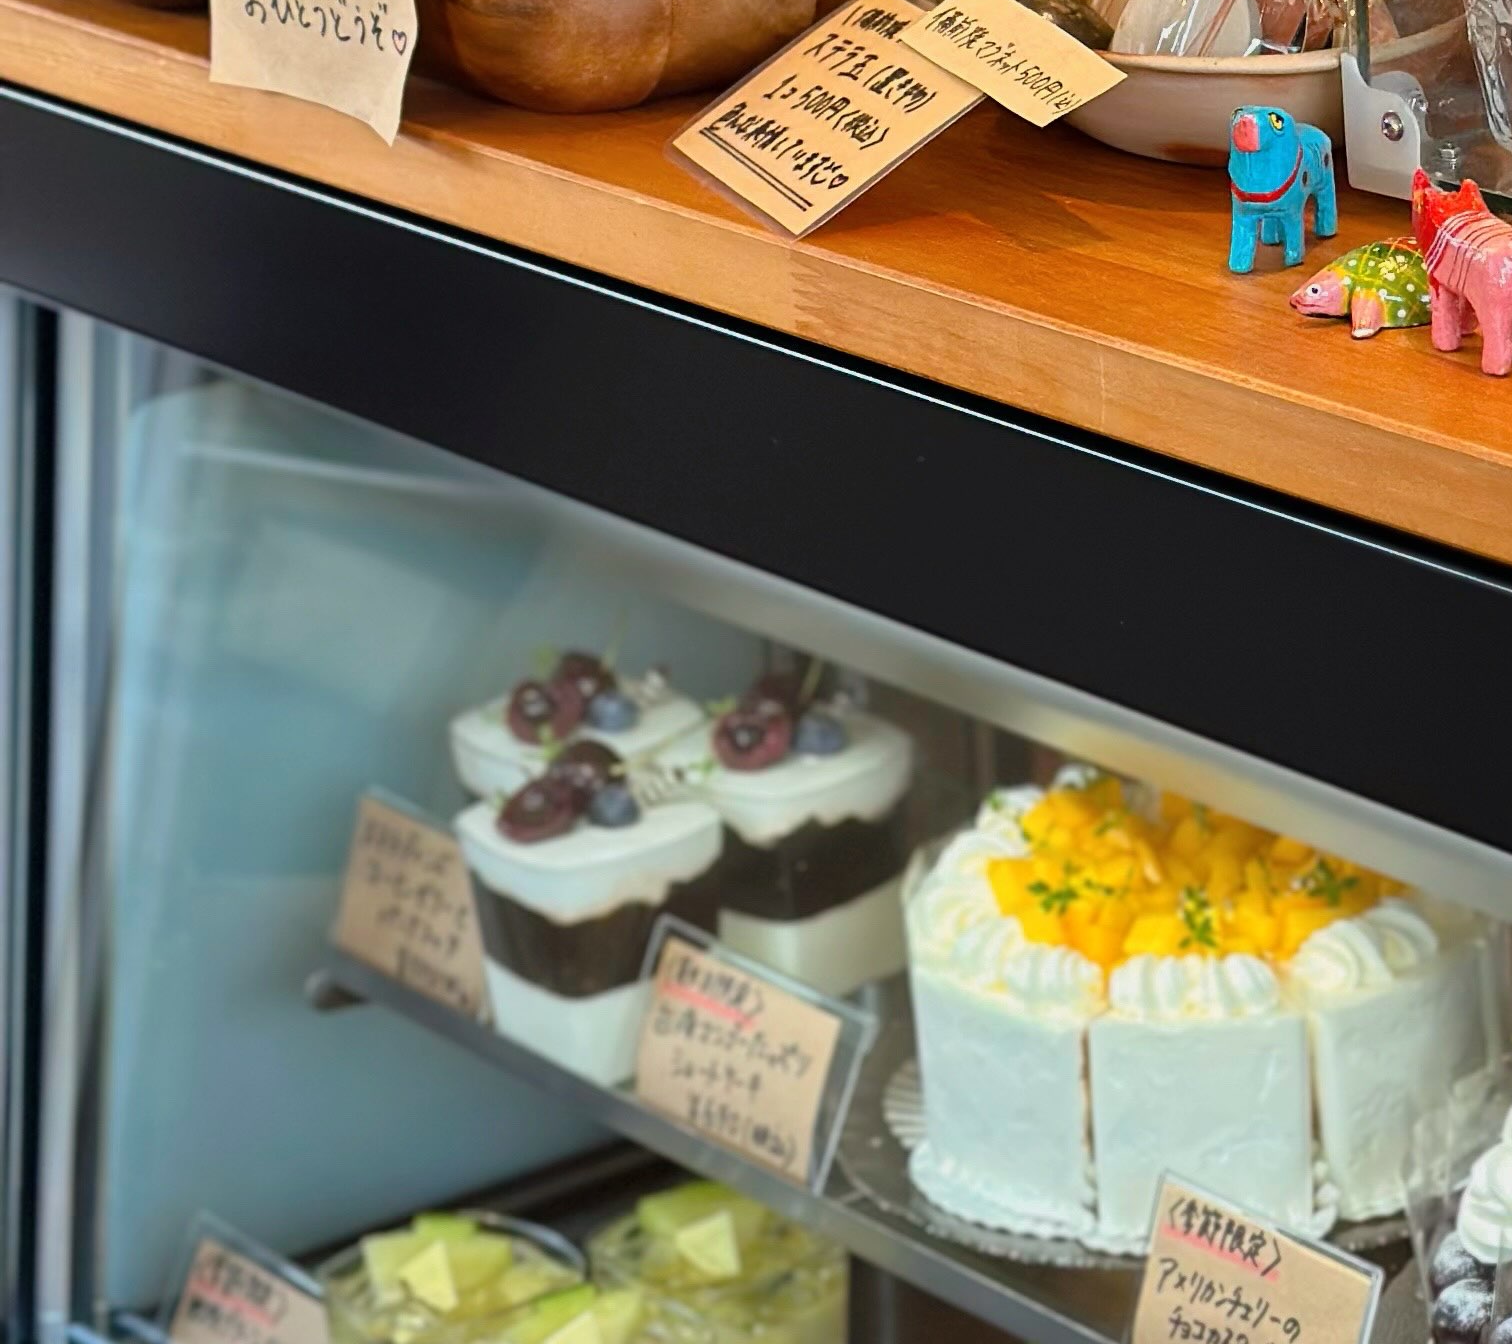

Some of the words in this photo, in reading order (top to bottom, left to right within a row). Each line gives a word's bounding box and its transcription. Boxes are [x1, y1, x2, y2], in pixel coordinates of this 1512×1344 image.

[1157, 1258, 1301, 1344] アメリカンチェリーの
